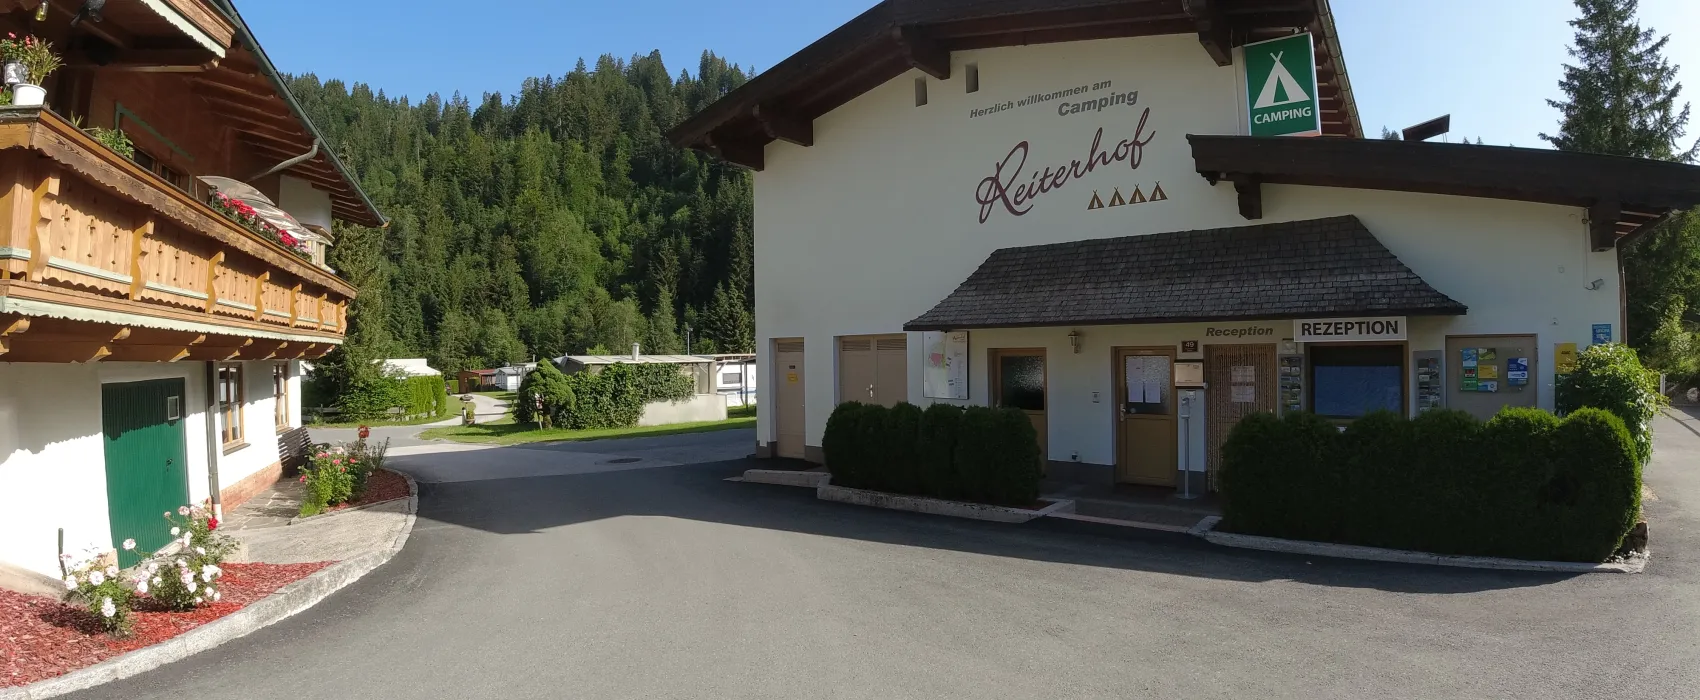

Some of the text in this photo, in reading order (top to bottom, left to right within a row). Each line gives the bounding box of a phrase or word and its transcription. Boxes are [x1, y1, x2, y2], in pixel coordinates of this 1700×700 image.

[969, 79, 1112, 119] Herzlich willkommen am
[1058, 90, 1139, 117] Camping
[1253, 106, 1312, 124] CAMPING
[975, 107, 1156, 224] Reiterhof
[1205, 326, 1274, 338] Reception
[1301, 320, 1399, 336] REZEPTION
